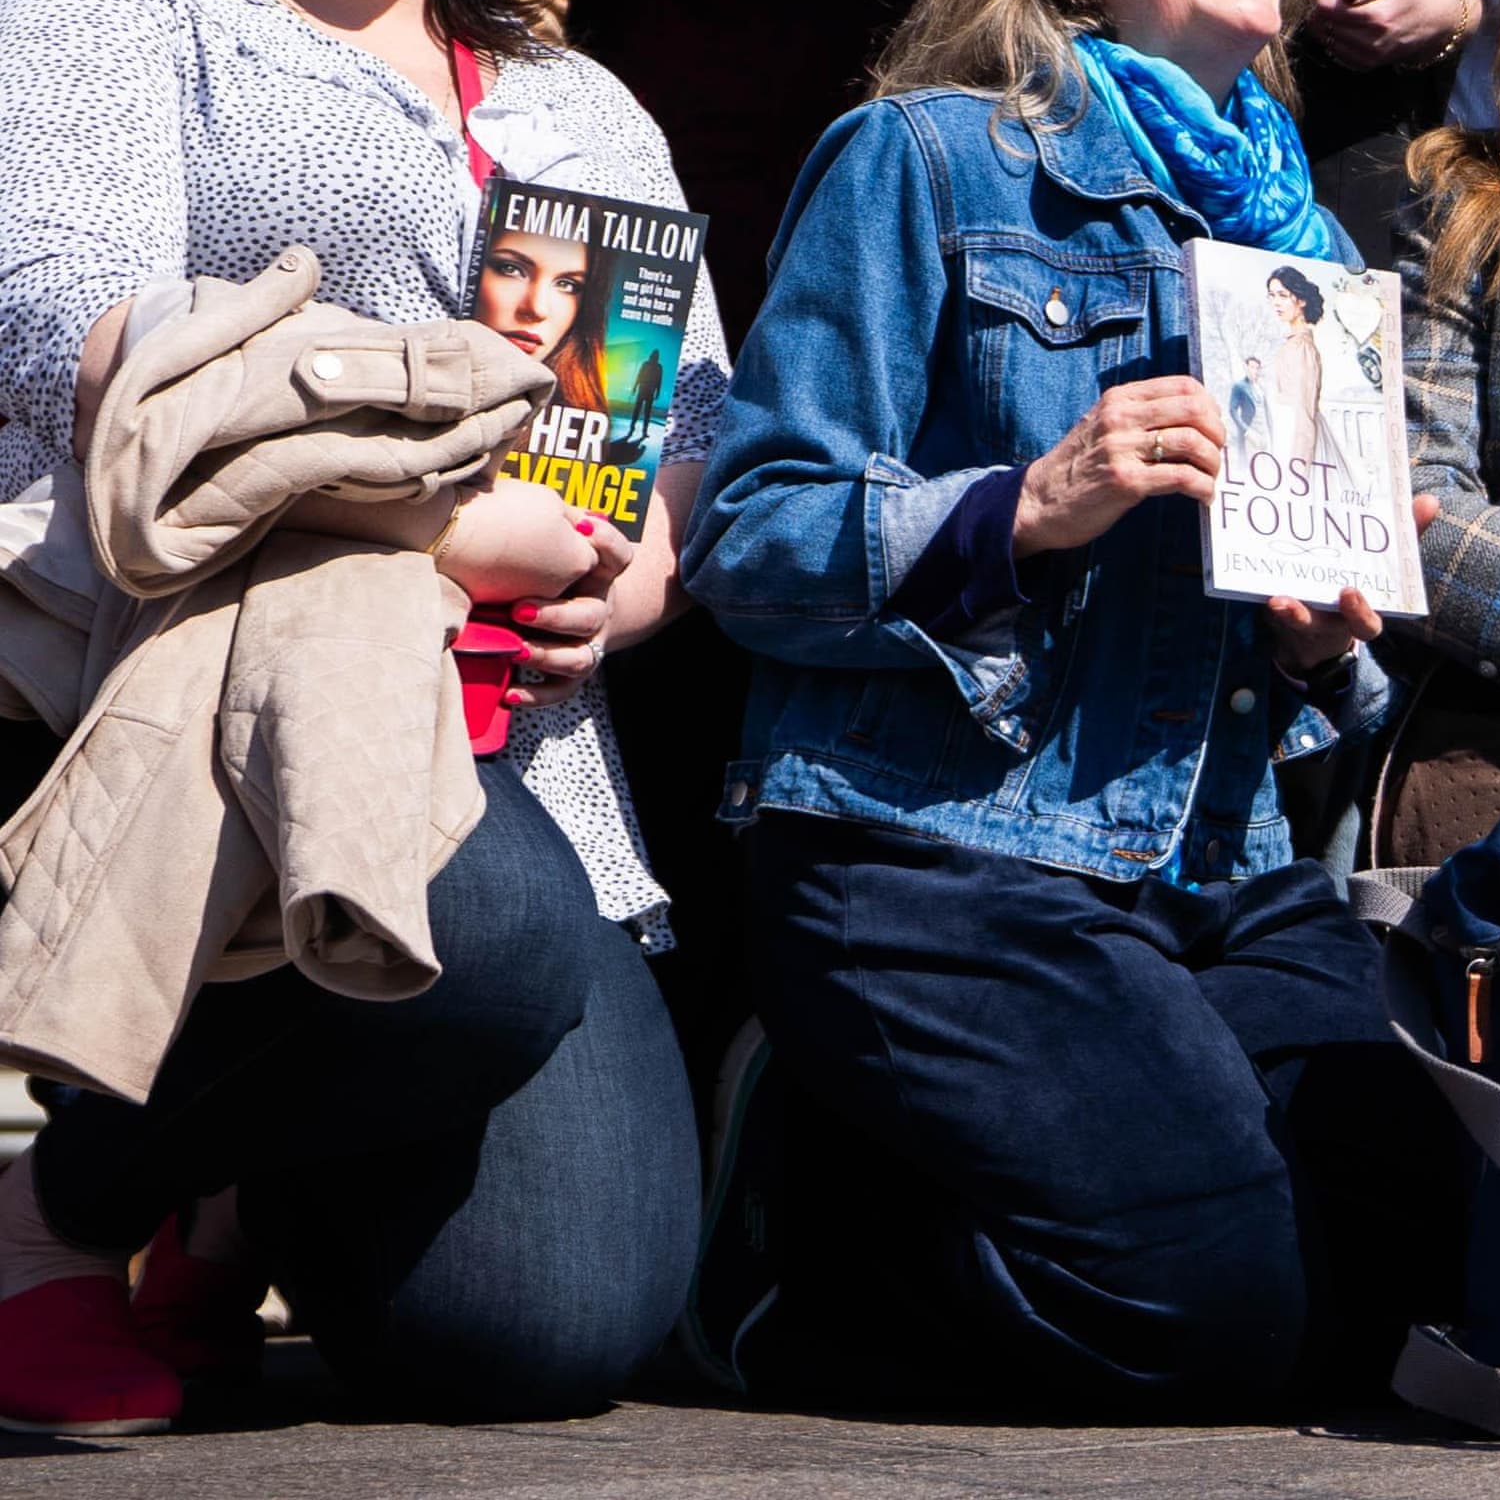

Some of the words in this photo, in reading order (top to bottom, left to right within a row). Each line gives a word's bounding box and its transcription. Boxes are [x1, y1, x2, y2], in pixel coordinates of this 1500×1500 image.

[504, 193, 590, 244] EMMA
[602, 211, 699, 263] TALLON
[527, 403, 609, 463] HER
[1223, 445, 1337, 502] LOST
[1341, 486, 1373, 508] and
[1220, 489, 1390, 553] FOUND
[1224, 552, 1288, 575] JENNY
[1291, 562, 1397, 593] WORSTALL
